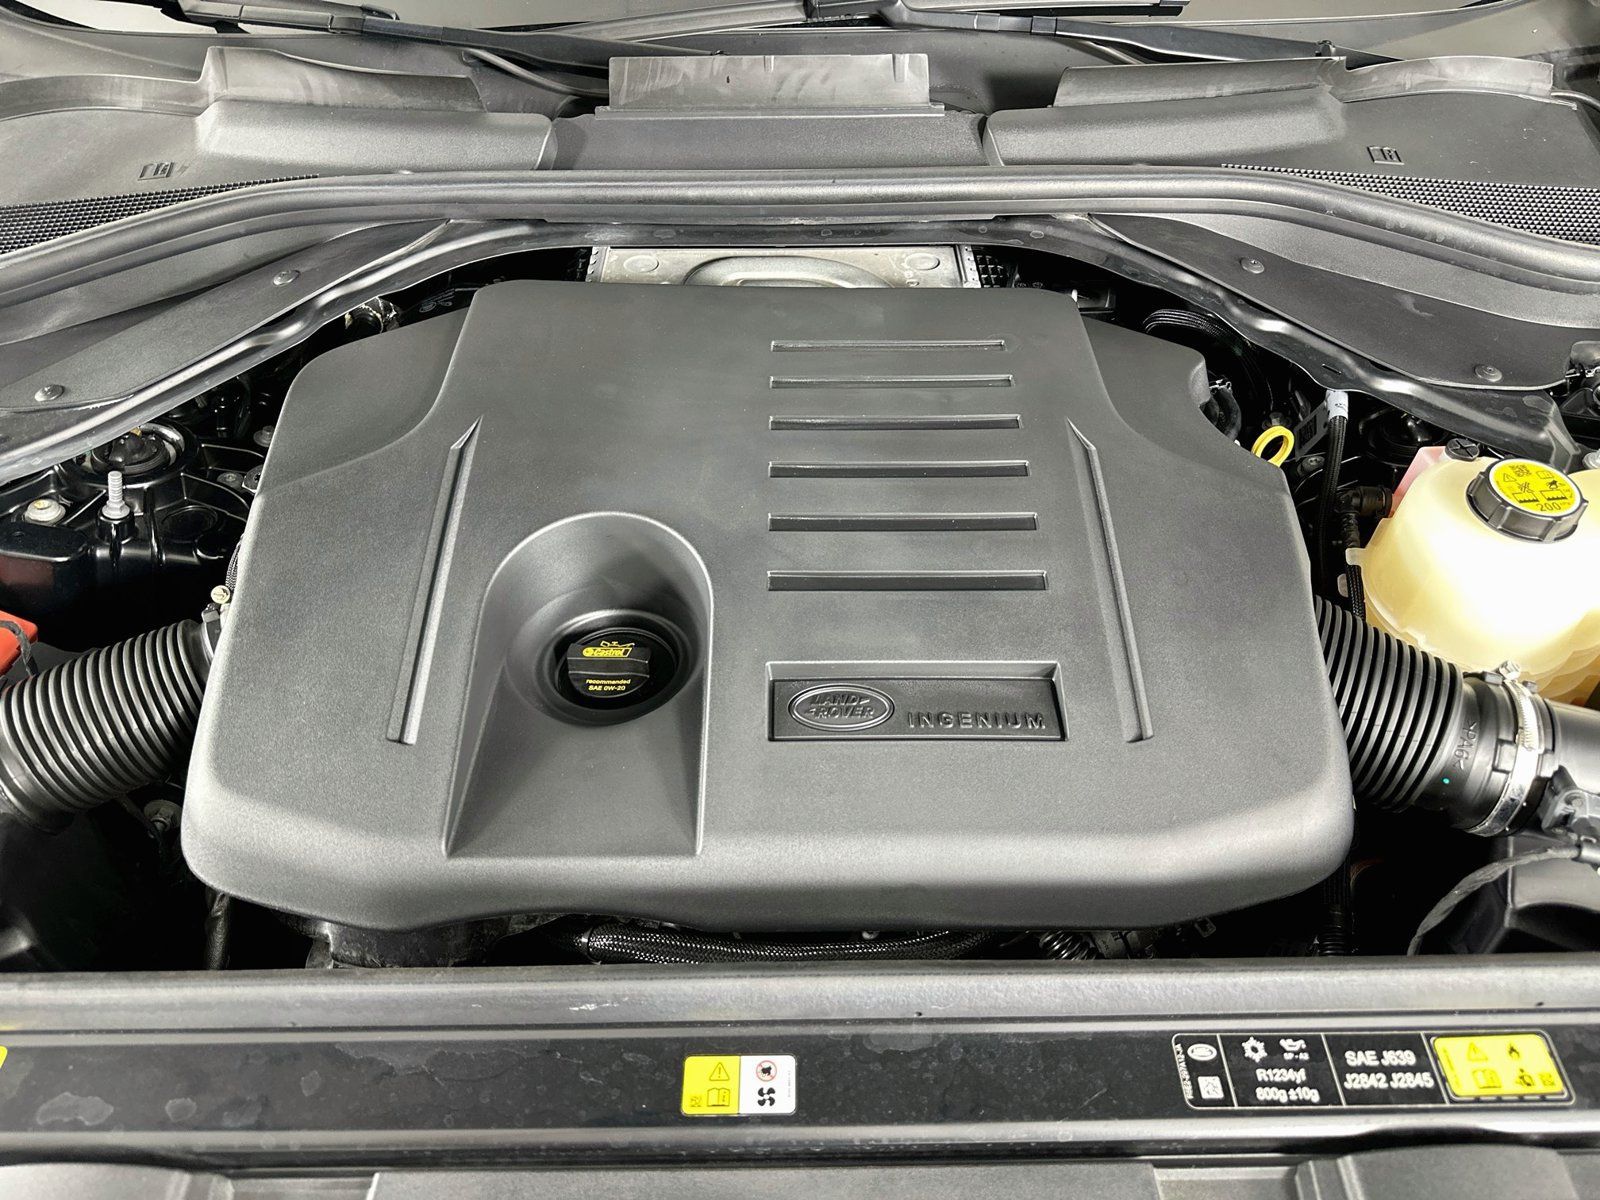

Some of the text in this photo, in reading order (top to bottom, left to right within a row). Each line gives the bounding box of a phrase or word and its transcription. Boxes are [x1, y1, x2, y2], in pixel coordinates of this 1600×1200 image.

[1536, 502, 1562, 512] 200
[811, 694, 859, 706] LAND
[815, 707, 874, 719] ROVER
[907, 711, 1046, 729] INGENIUM
[1344, 1050, 1416, 1067] SAE J639
[1344, 1072, 1434, 1089] J2842 J2845
